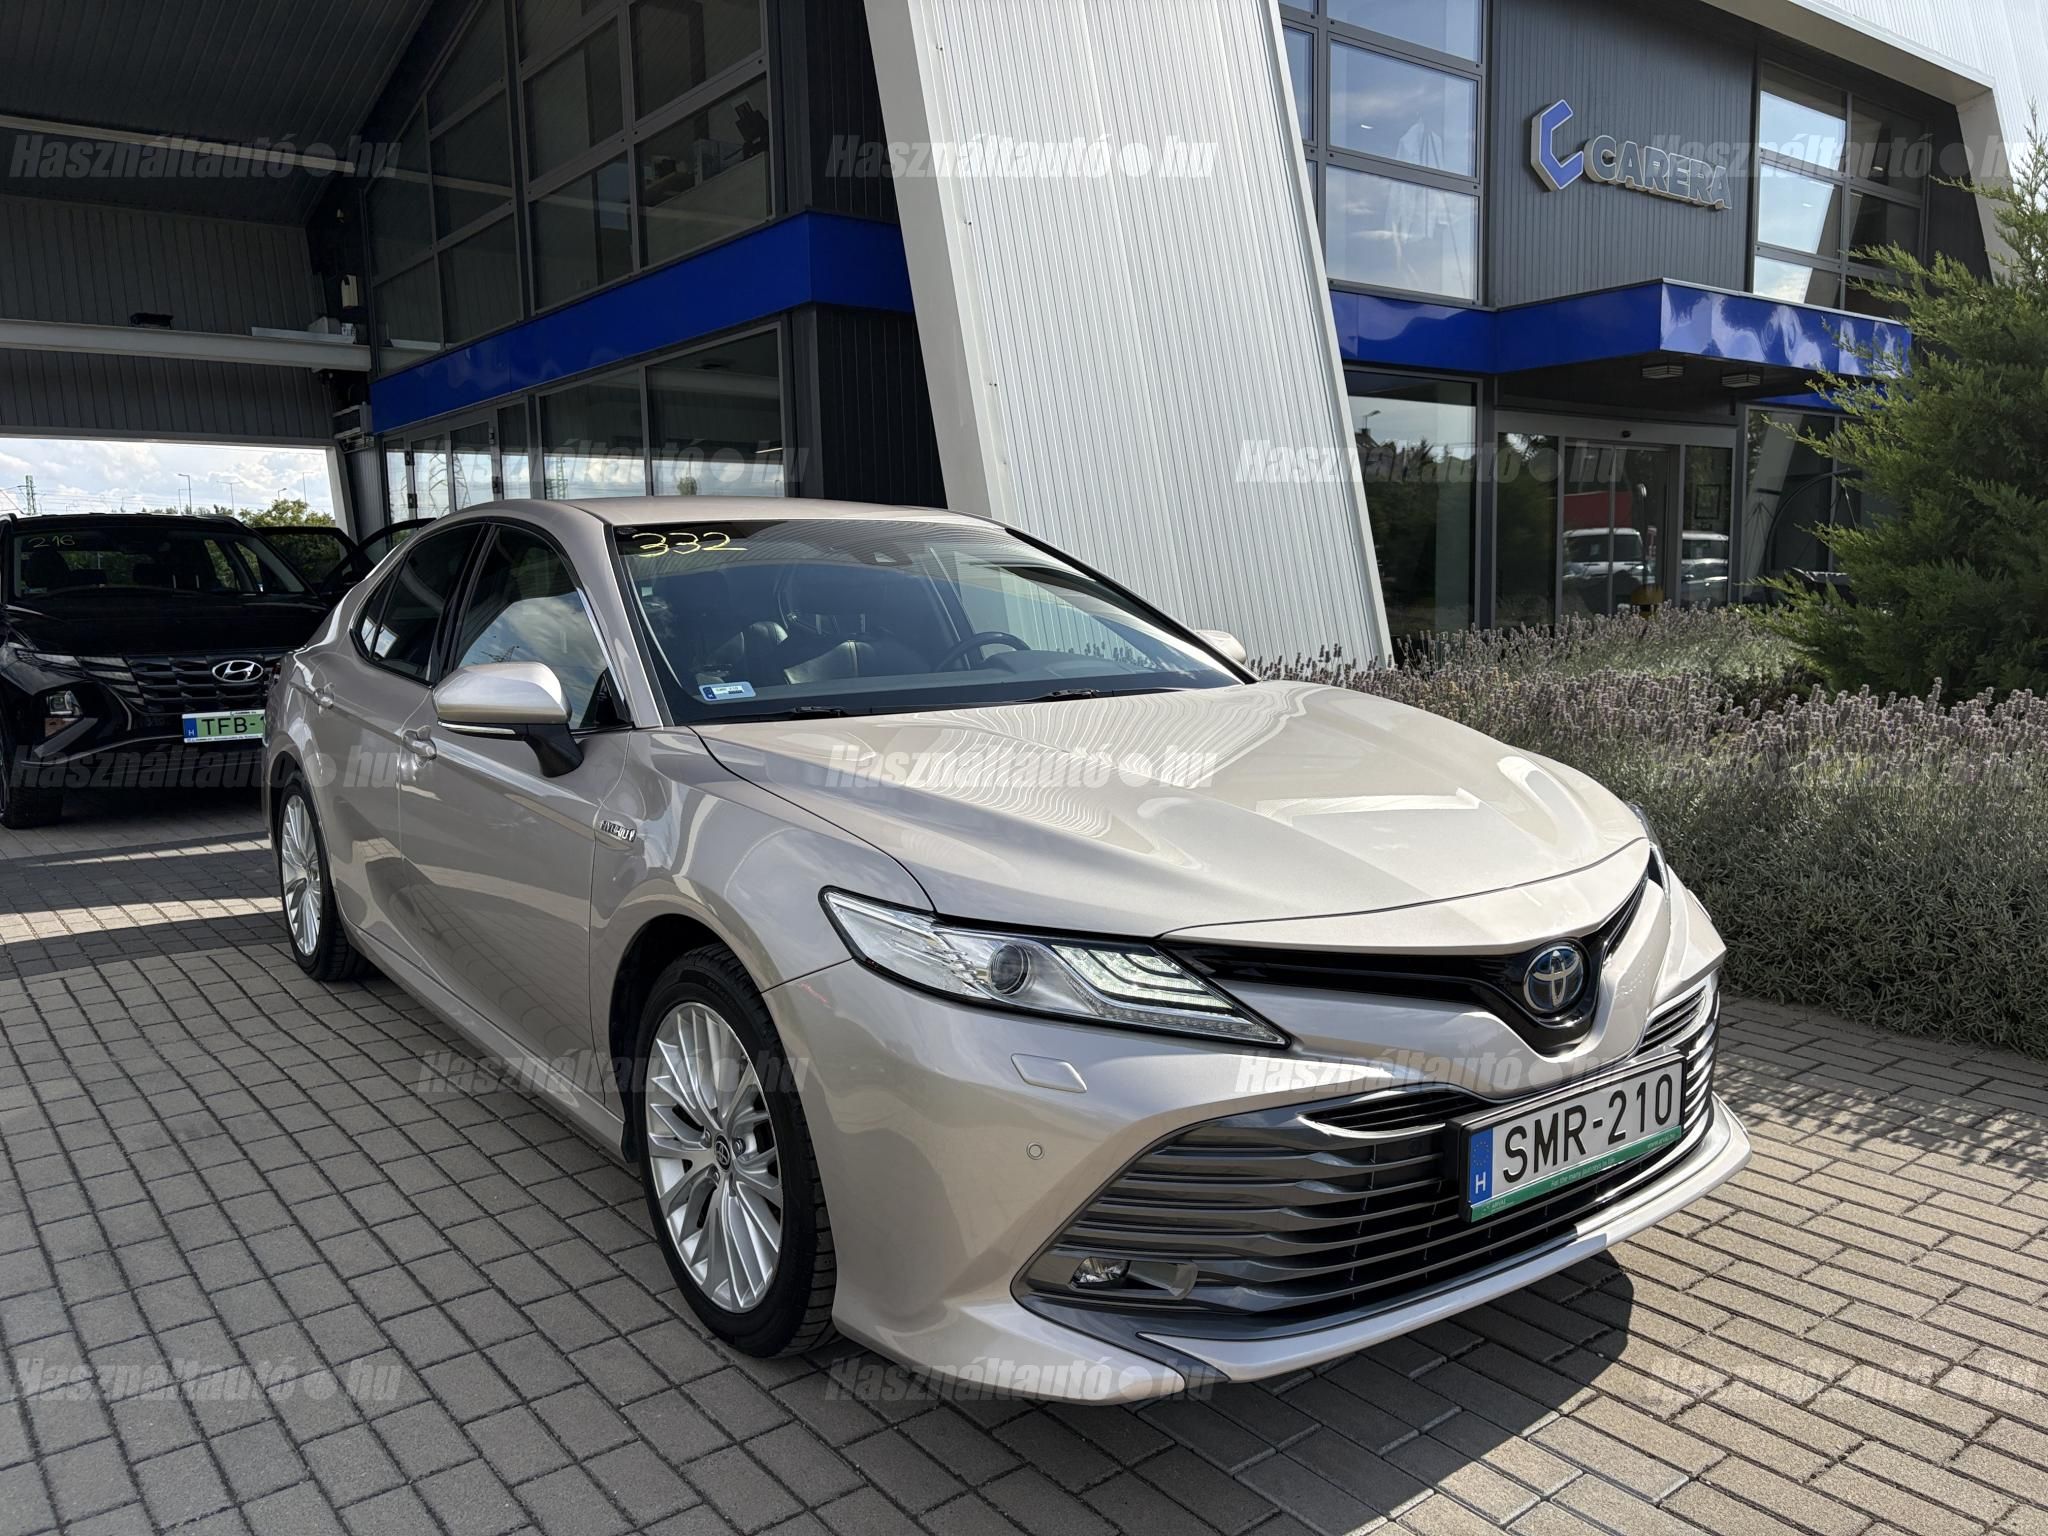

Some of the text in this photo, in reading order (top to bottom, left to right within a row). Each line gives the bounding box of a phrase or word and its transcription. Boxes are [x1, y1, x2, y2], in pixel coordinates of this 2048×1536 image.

[1585, 134, 1732, 210] CARERA
[28, 534, 75, 548] 216
[632, 531, 748, 557] 332
[1475, 1073, 1673, 1195] H SMR-210
